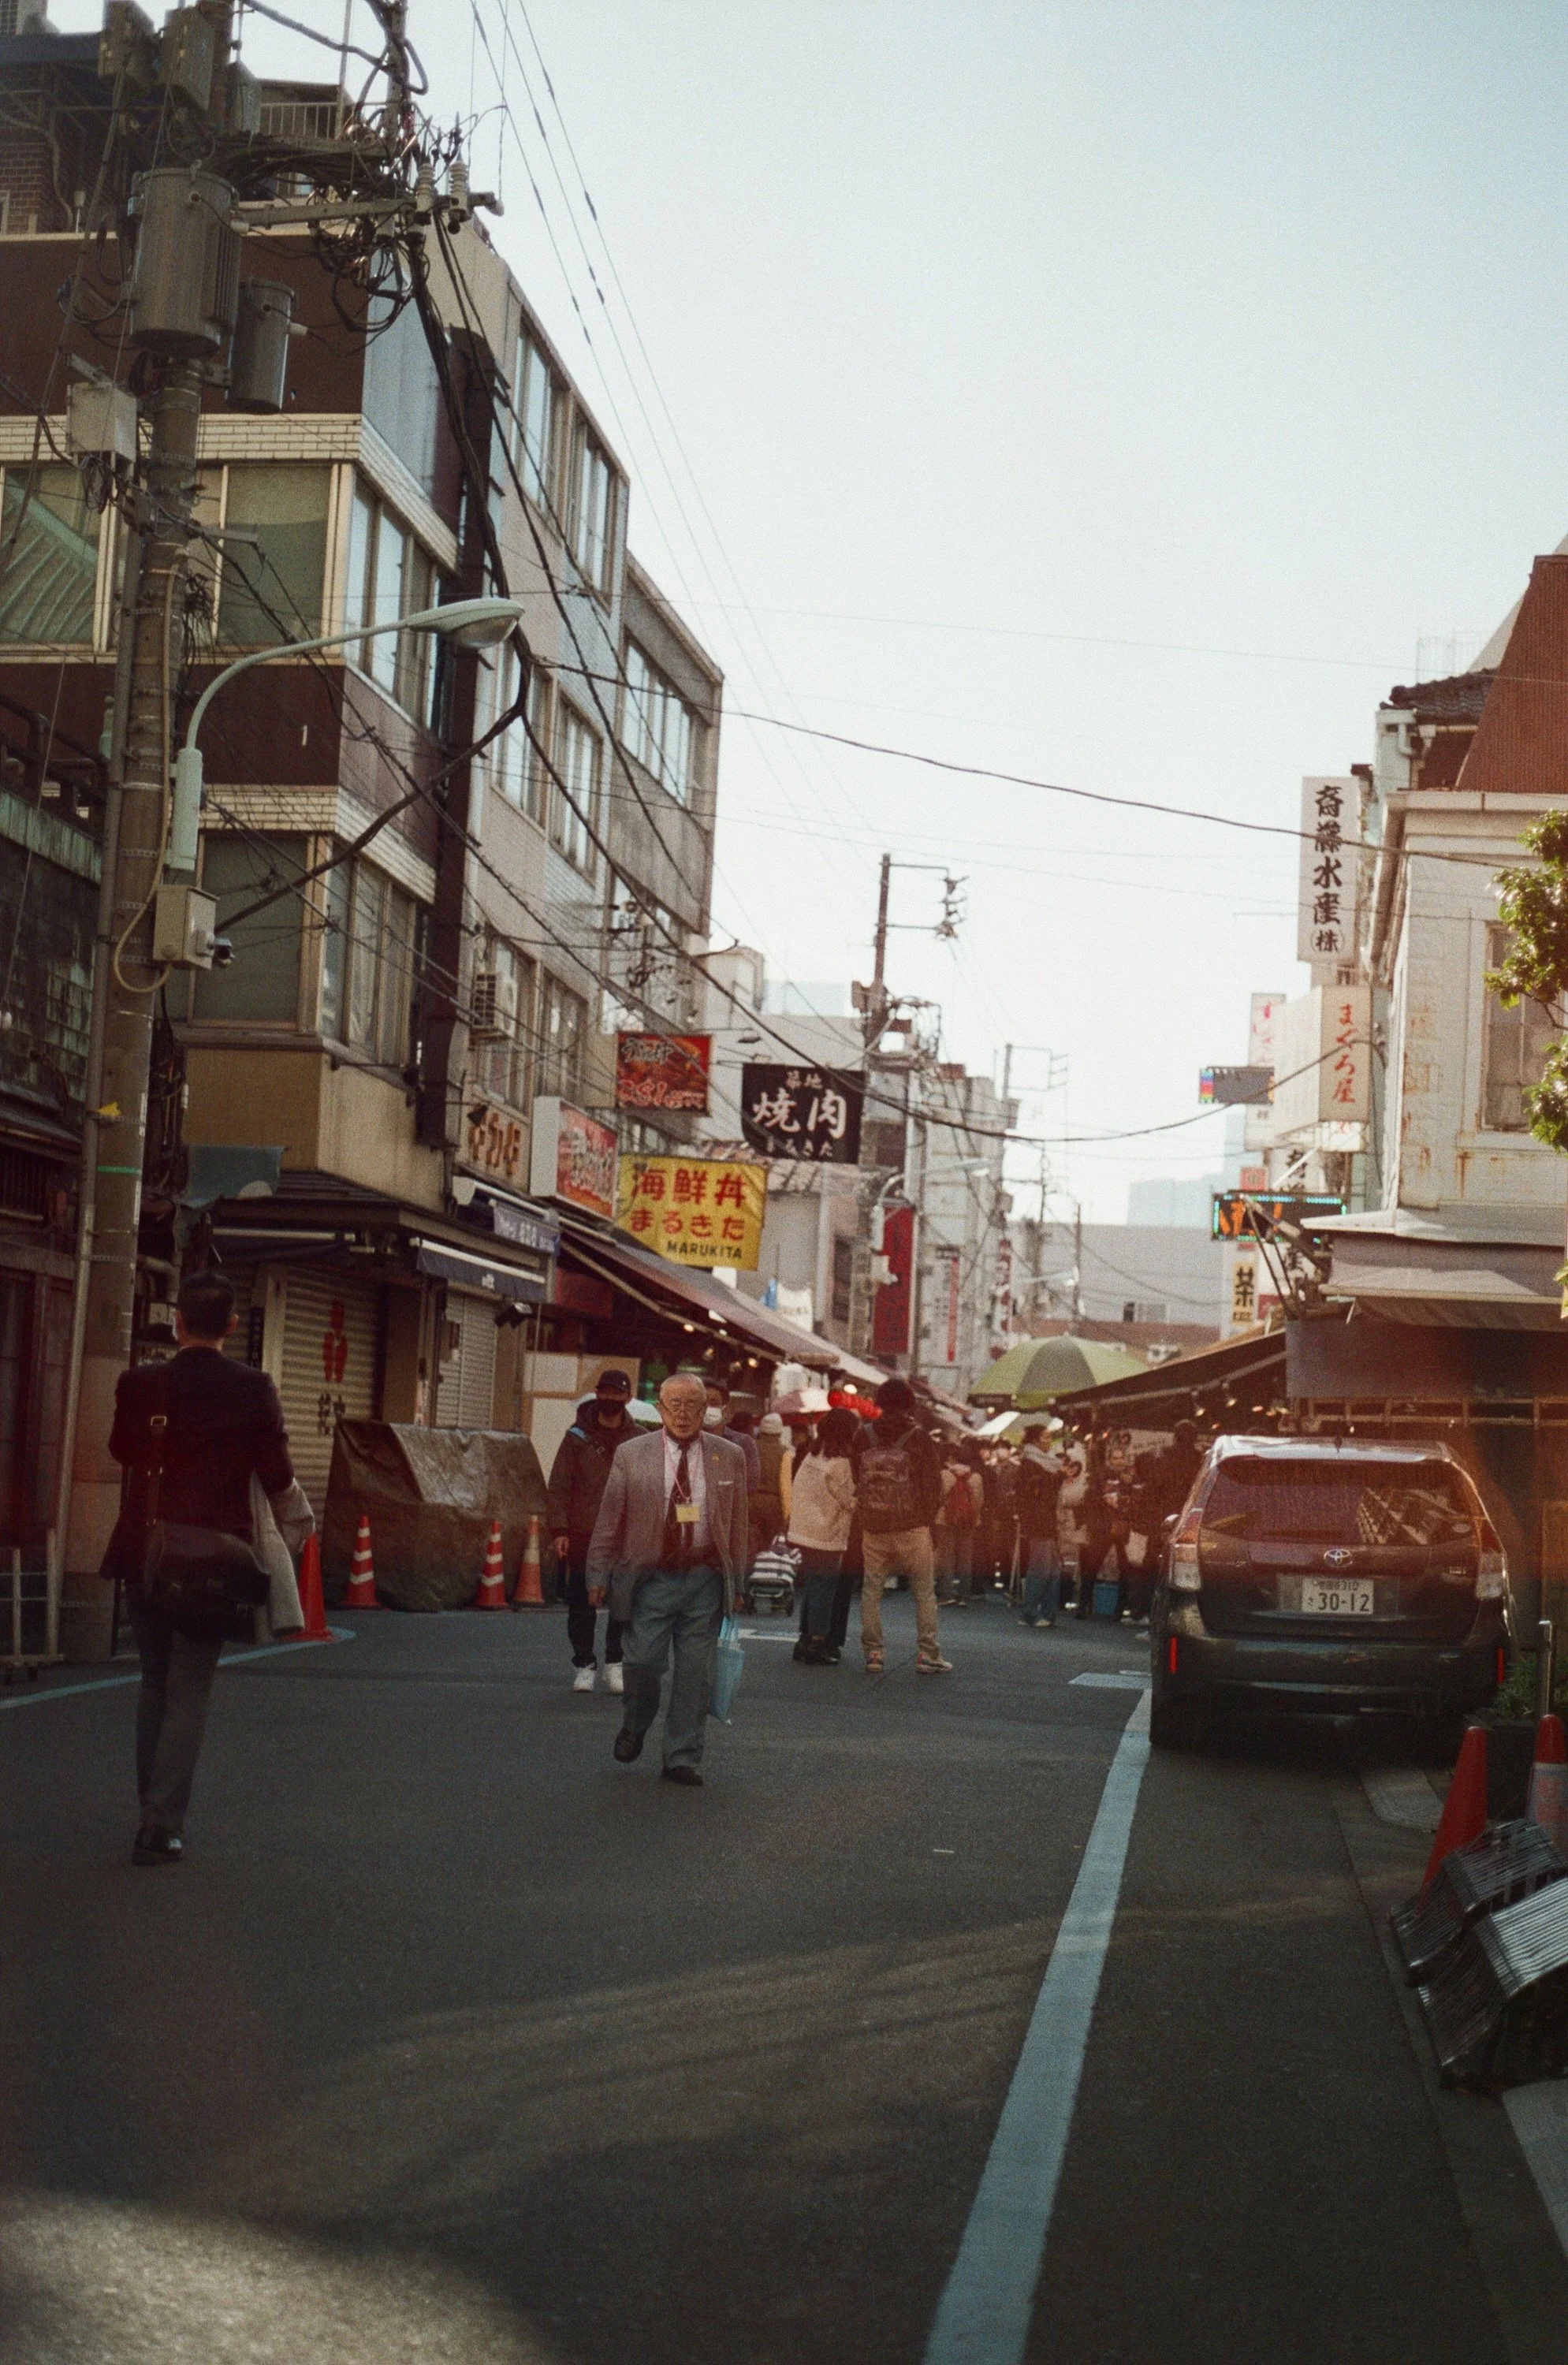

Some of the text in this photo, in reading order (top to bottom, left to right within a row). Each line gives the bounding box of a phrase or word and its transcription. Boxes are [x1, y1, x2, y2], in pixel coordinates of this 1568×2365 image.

[751, 1087, 848, 1140] 焼肉
[631, 1166, 747, 1209] 海鮮丼
[630, 1207, 746, 1242] まるきた
[666, 1240, 743, 1259] MARUKITA
[1317, 1592, 1370, 1612] 30-12
